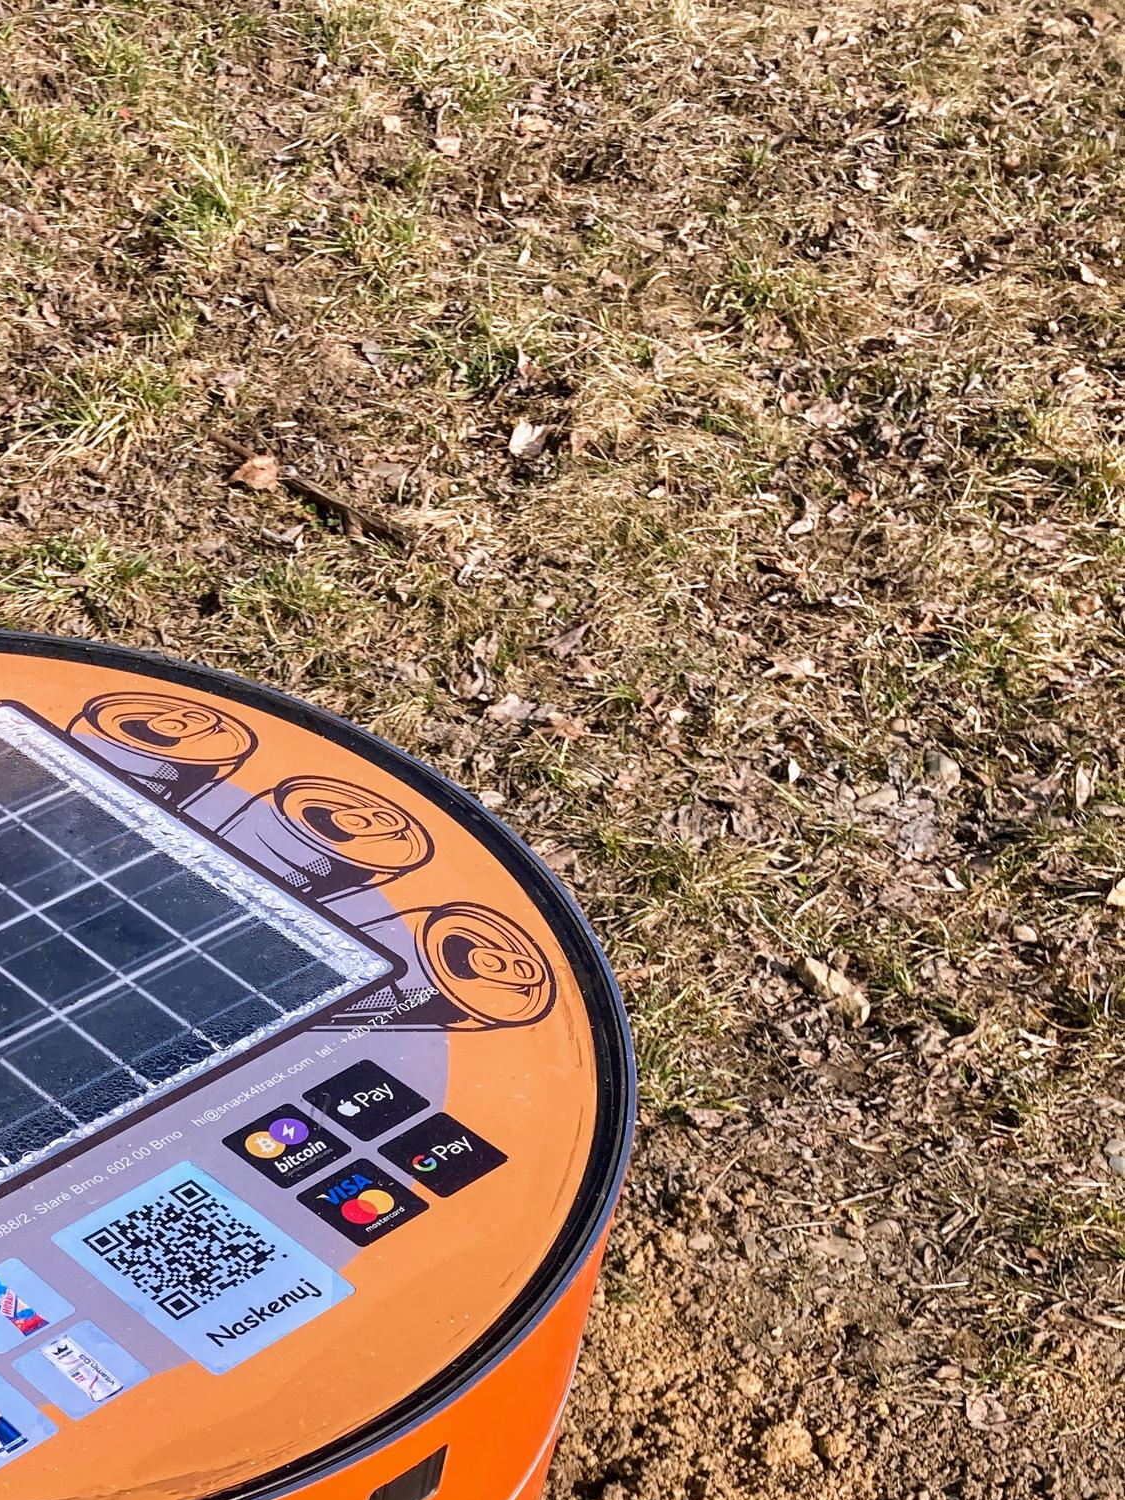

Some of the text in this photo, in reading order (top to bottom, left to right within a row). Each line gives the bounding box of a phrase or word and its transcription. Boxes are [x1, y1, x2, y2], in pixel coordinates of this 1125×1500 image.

[34, 1191, 72, 1216] Staré
[69, 1174, 109, 1196] Brno,
[106, 1157, 134, 1175] 602
[133, 1146, 151, 1161] 00
[149, 1130, 183, 1151] Brno
[191, 1056, 315, 1128] hi@snack4track.com
[315, 1043, 340, 1060] tel.:
[340, 1024, 370, 1045] +420
[368, 1010, 393, 1027] 721
[391, 997, 416, 1016] 702
[353, 1082, 394, 1108] Pay
[274, 1139, 327, 1174] bitcoin
[431, 1135, 473, 1161] Pay
[316, 1172, 373, 1206] VISA
[365, 1205, 406, 1234] mastercard
[206, 1277, 322, 1348] Naskenuj
